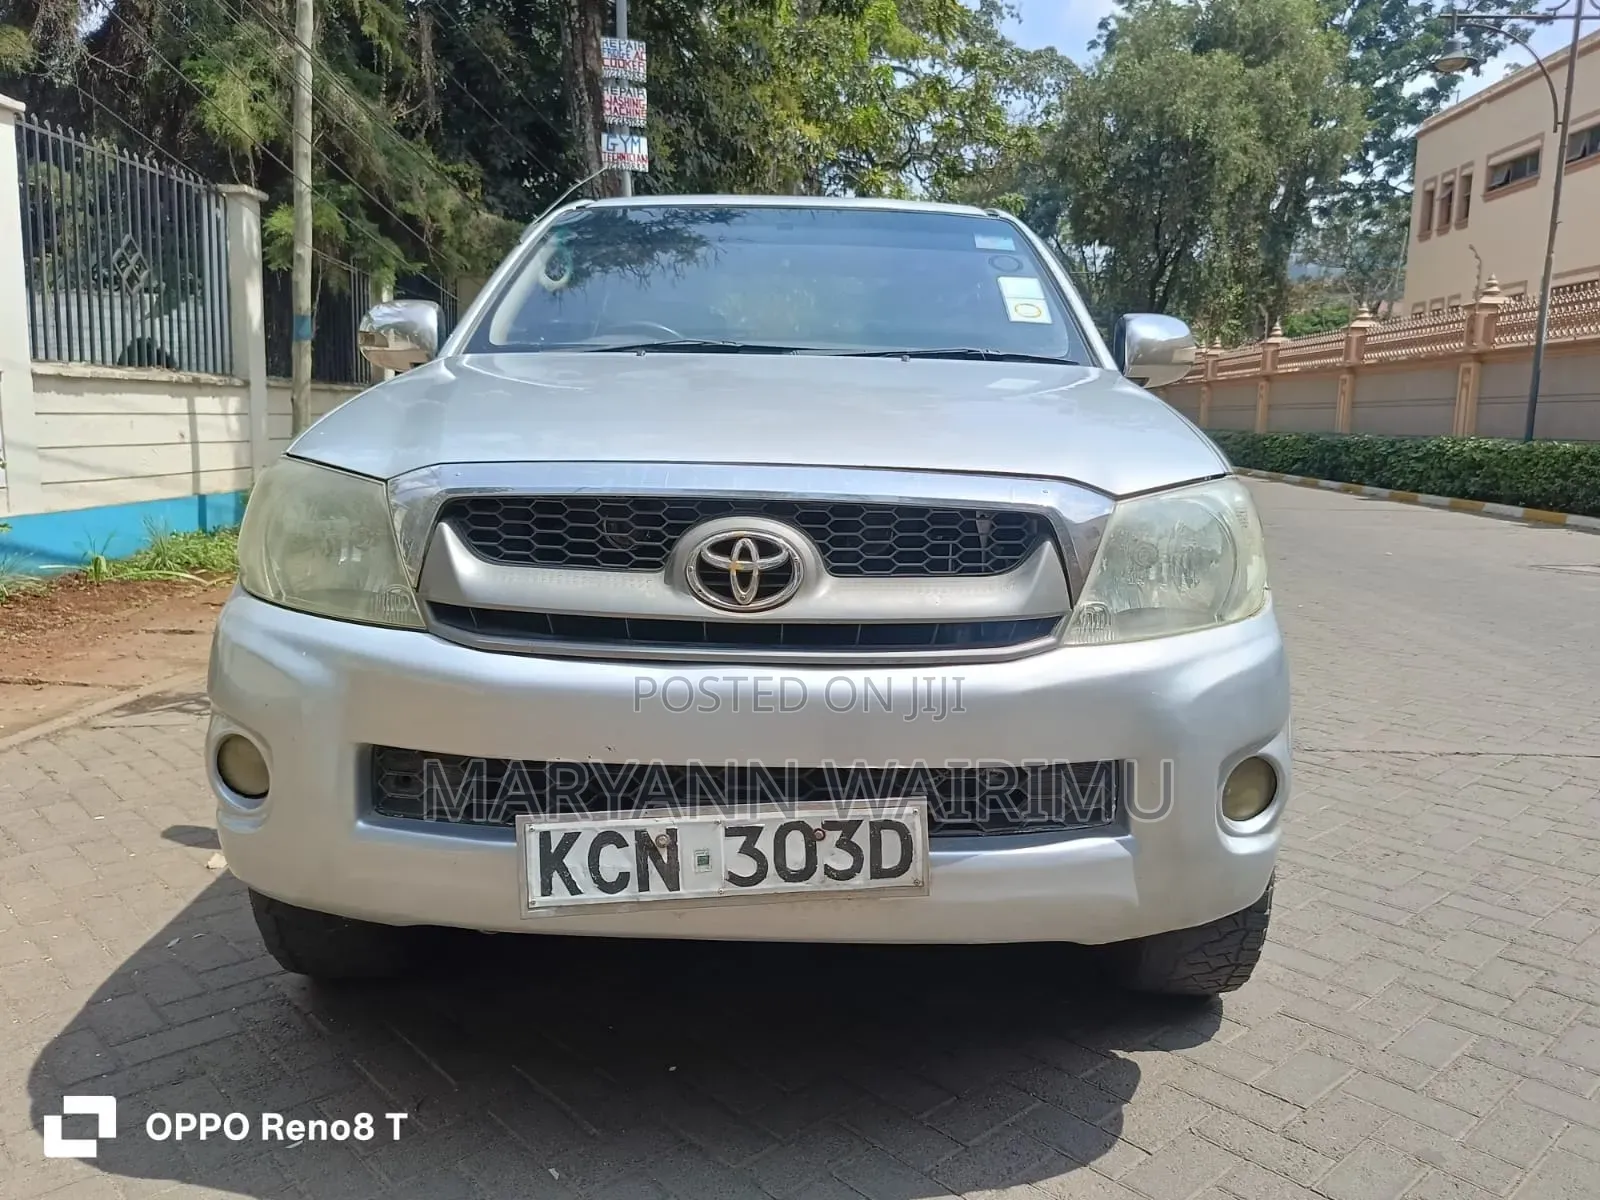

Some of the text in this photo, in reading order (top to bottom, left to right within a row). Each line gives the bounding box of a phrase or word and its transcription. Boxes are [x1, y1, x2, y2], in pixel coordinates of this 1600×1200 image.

[602, 39, 645, 51] REPAIR
[602, 58, 646, 71] COOKER
[602, 87, 646, 98] REPAIR
[606, 134, 641, 153] GYM
[602, 152, 648, 165] TECHNICIAN
[538, 818, 914, 897] KCN 303D
